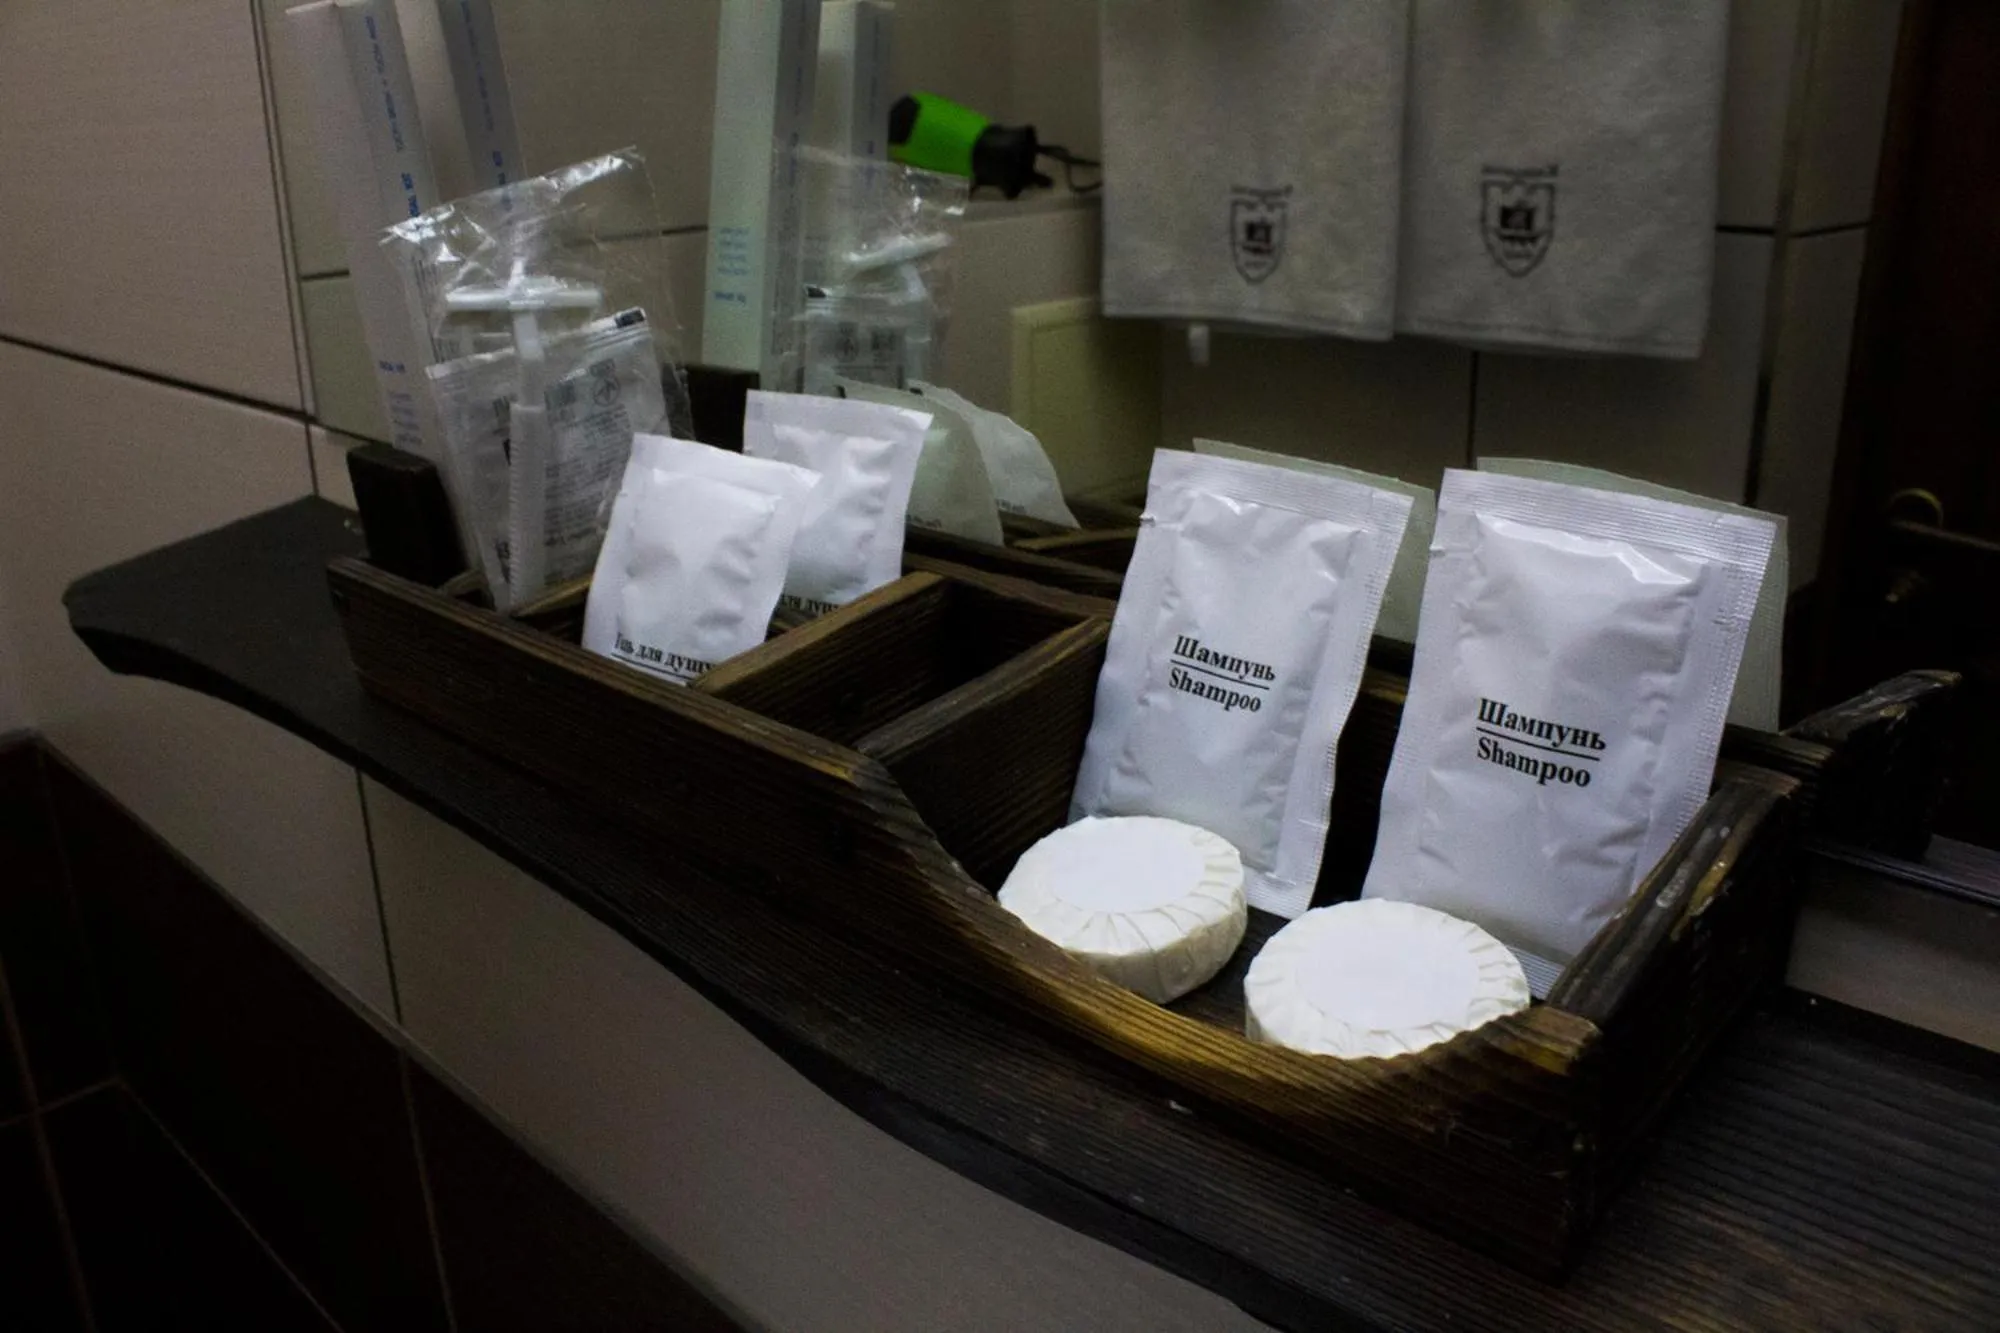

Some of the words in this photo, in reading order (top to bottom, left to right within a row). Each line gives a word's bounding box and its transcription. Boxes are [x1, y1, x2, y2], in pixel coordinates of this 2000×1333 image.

[1173, 634, 1276, 681] Шампунь
[1169, 667, 1262, 712] Shampoo
[1477, 698, 1606, 750] Шампунь
[1477, 736, 1591, 788] Shampoo
